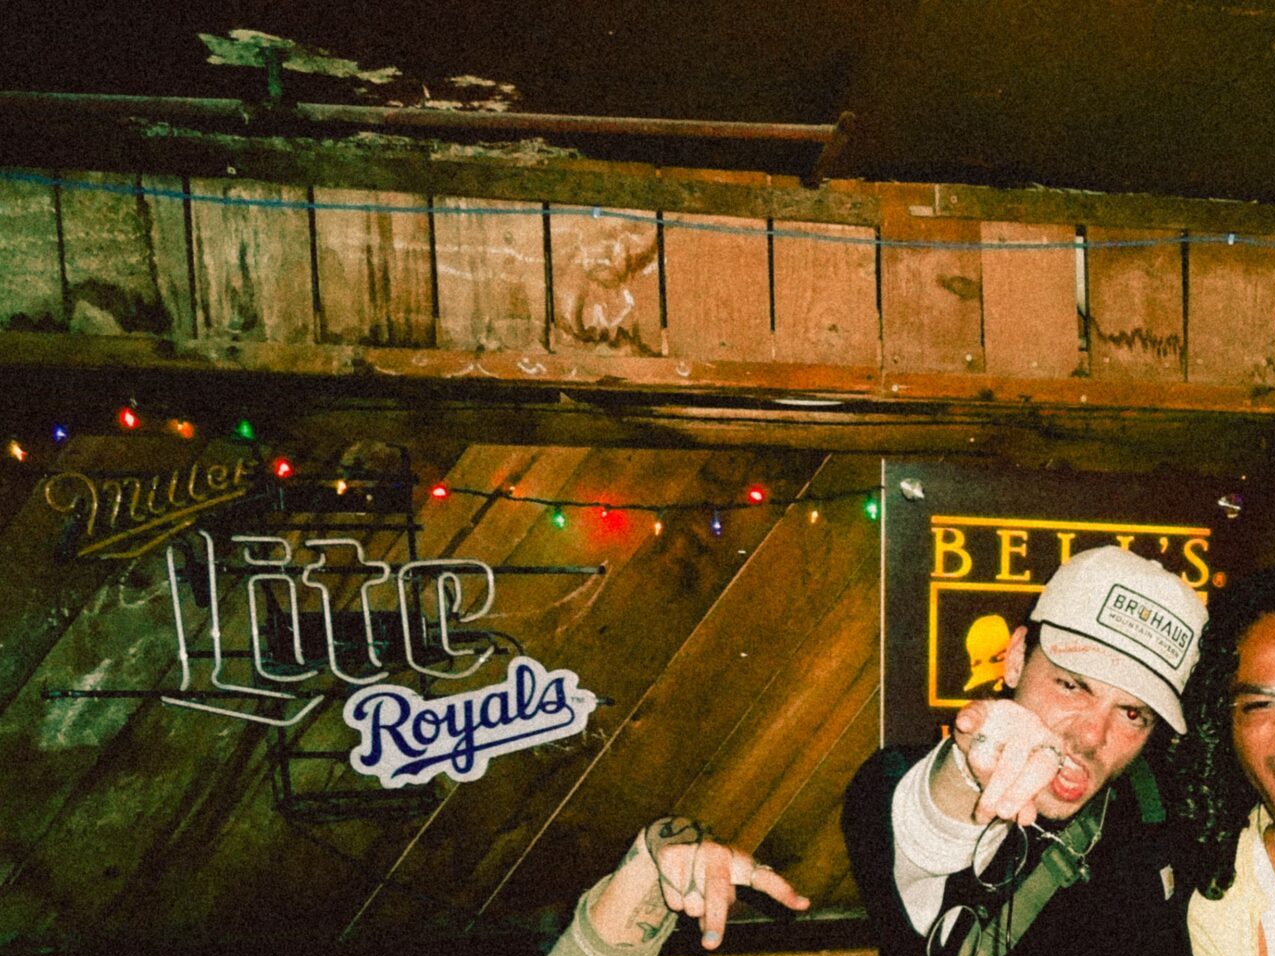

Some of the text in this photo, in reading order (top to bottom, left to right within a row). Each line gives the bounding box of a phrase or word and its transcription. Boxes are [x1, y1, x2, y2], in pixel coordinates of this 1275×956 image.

[161, 530, 496, 727] Lite
[1108, 612, 1180, 659] MOUNTAIN TAVERN
[353, 662, 571, 775] Royals
